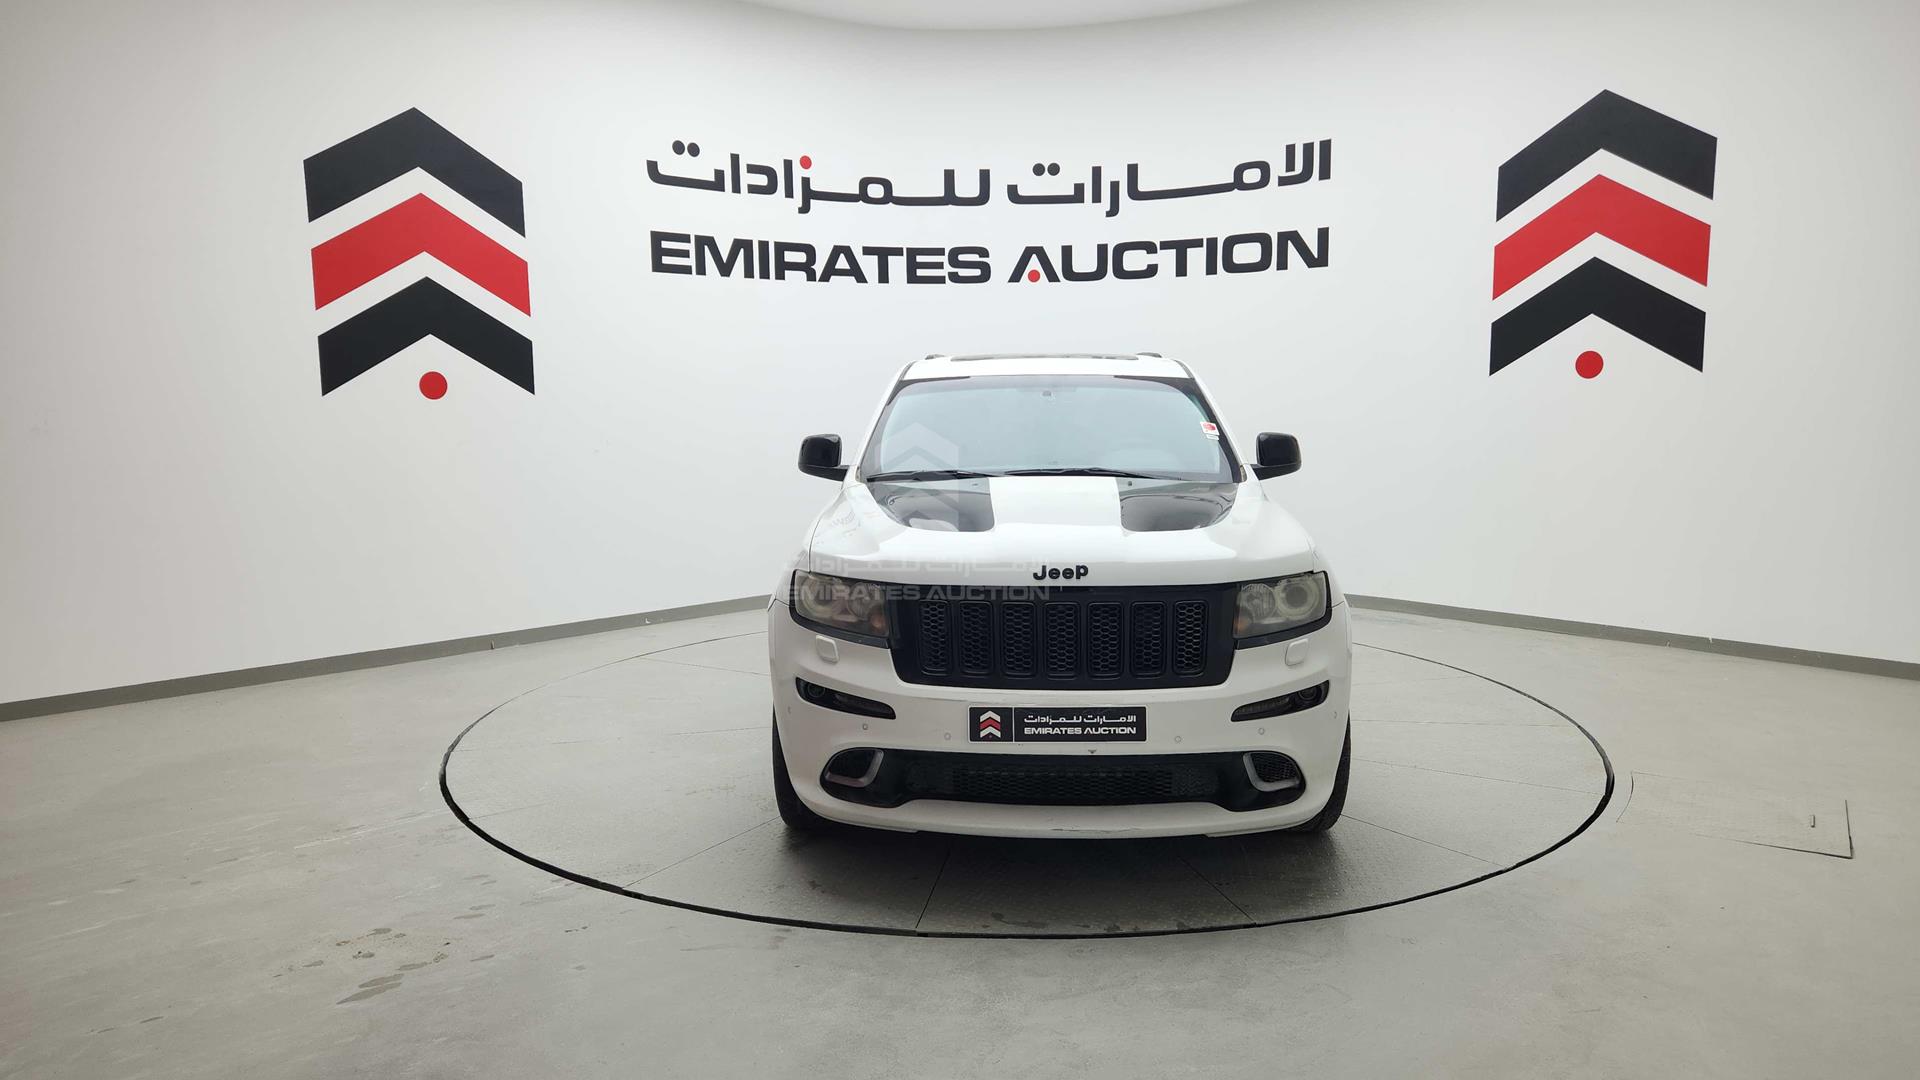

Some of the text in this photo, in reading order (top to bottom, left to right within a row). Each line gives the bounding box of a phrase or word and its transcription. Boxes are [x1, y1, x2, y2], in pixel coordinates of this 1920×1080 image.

[646, 139, 1331, 217] الامارات للمزادات
[650, 226, 1329, 284] EMIRATES AUCTION
[1032, 564, 1089, 581] Jeep
[1024, 727, 1137, 735] EMIRATES AUCTION
